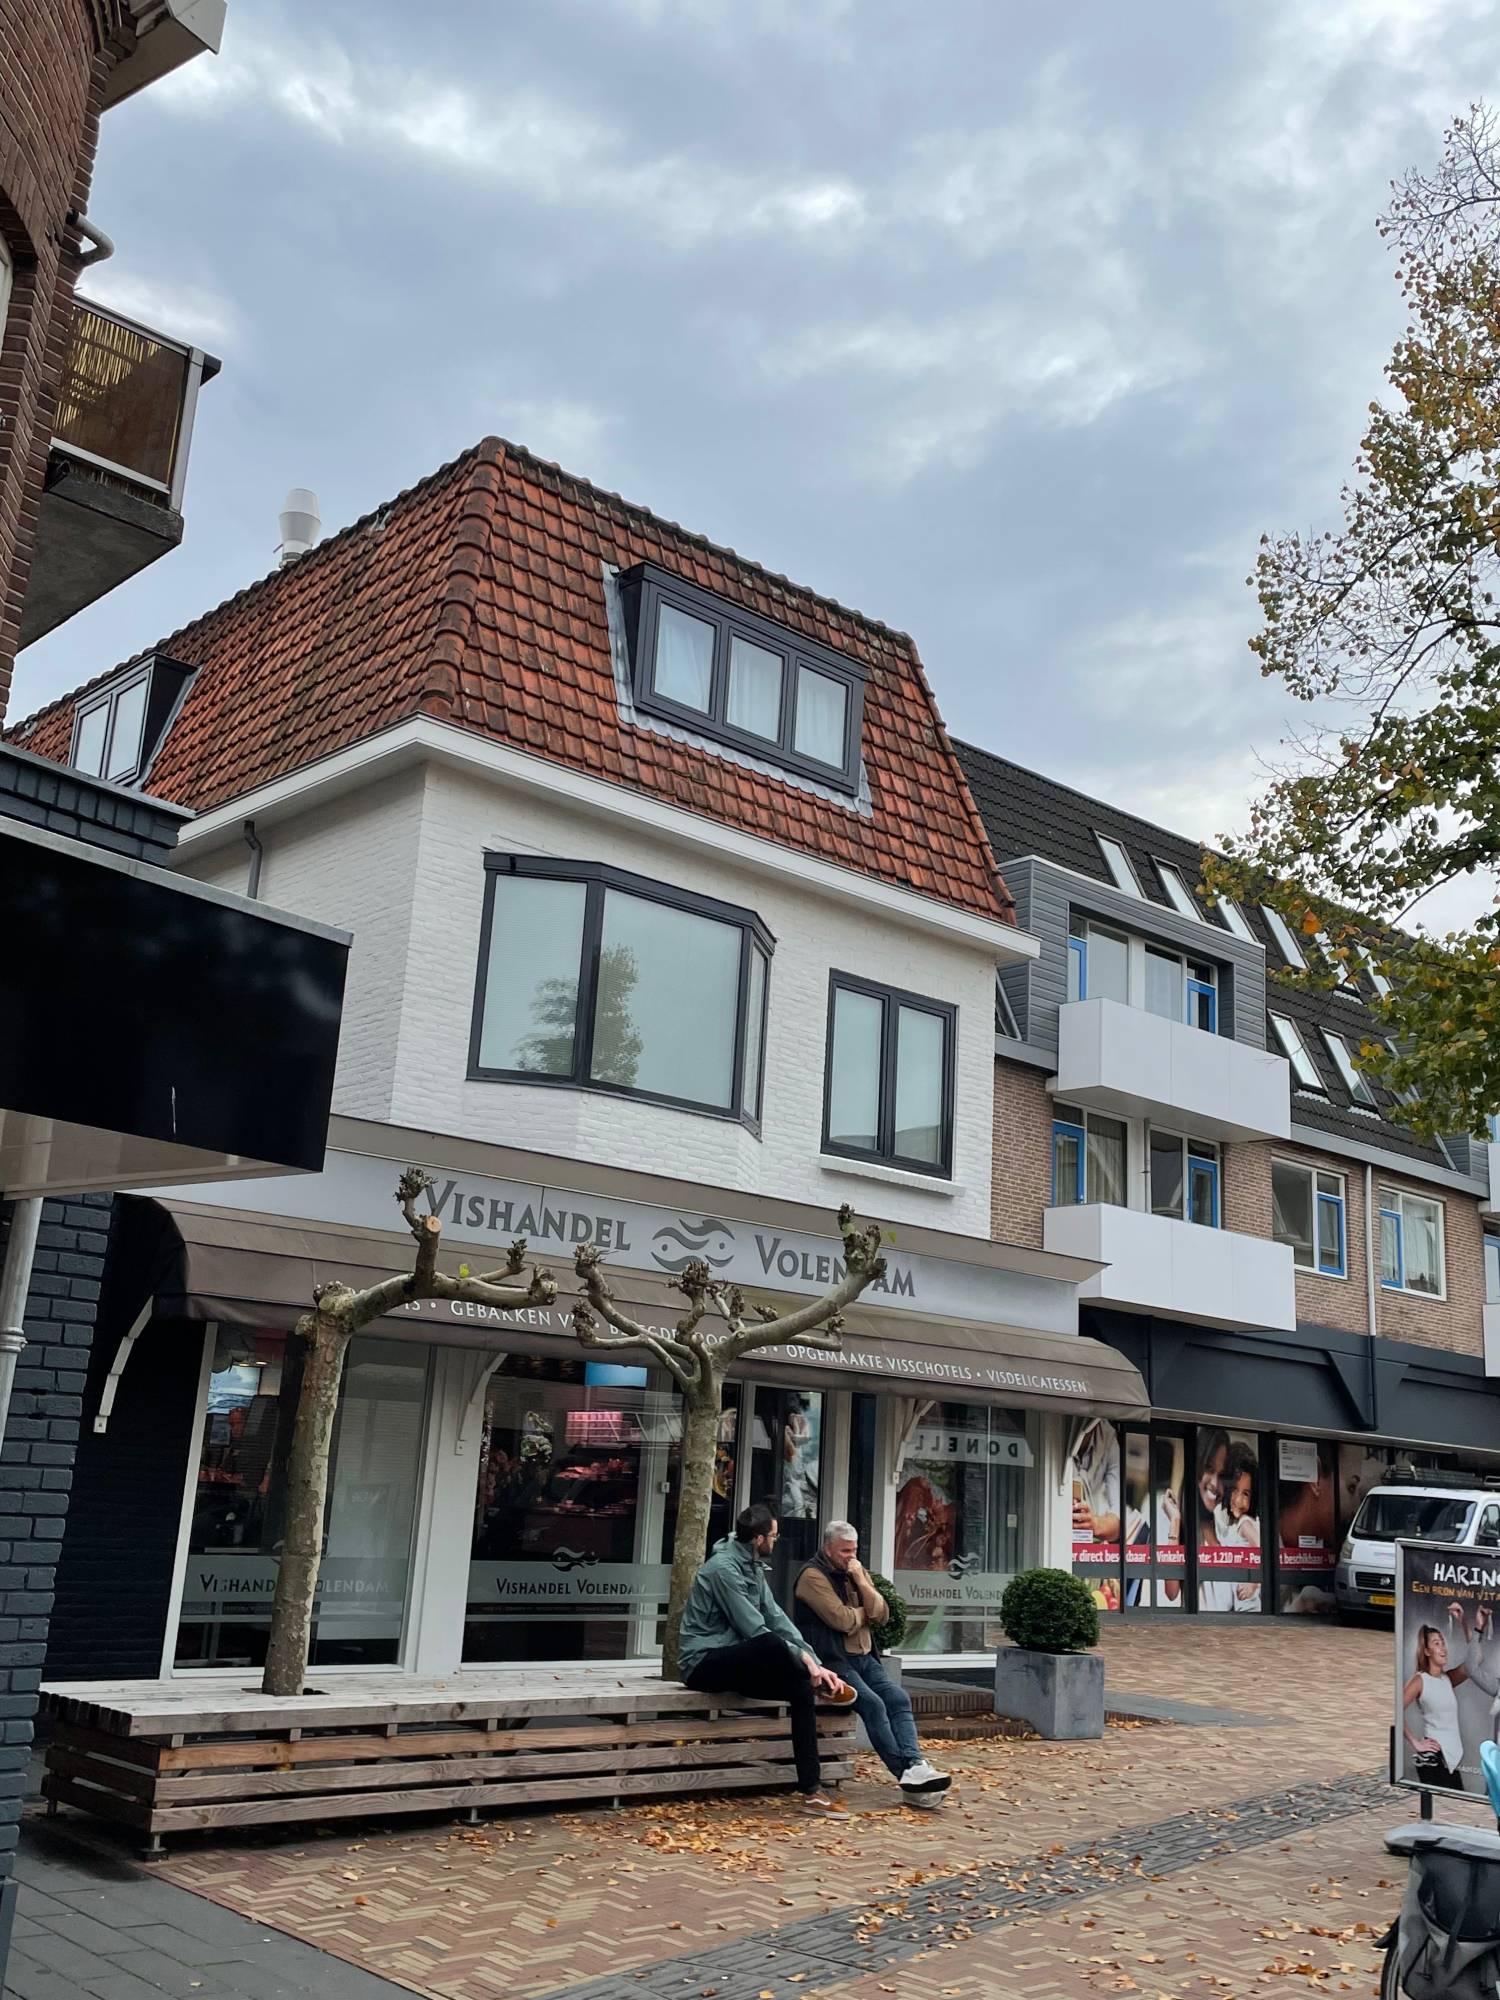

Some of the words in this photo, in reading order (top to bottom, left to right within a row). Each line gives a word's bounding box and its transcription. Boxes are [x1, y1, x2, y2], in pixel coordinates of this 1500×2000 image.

[424, 1179, 631, 1251] VISHANDEL
[755, 1234, 916, 1298] VOLENAM
[786, 1344, 884, 1369] OPGEMAAKTE
[887, 1357, 972, 1380] VISSCHOTELS
[986, 1369, 1088, 1393] VISDELICATESSEN
[1079, 1549, 1104, 1562] direct
[1213, 1552, 1233, 1563] 1.210
[495, 1577, 571, 1595] VISHANDEL
[909, 1584, 962, 1599] VISHANDEL
